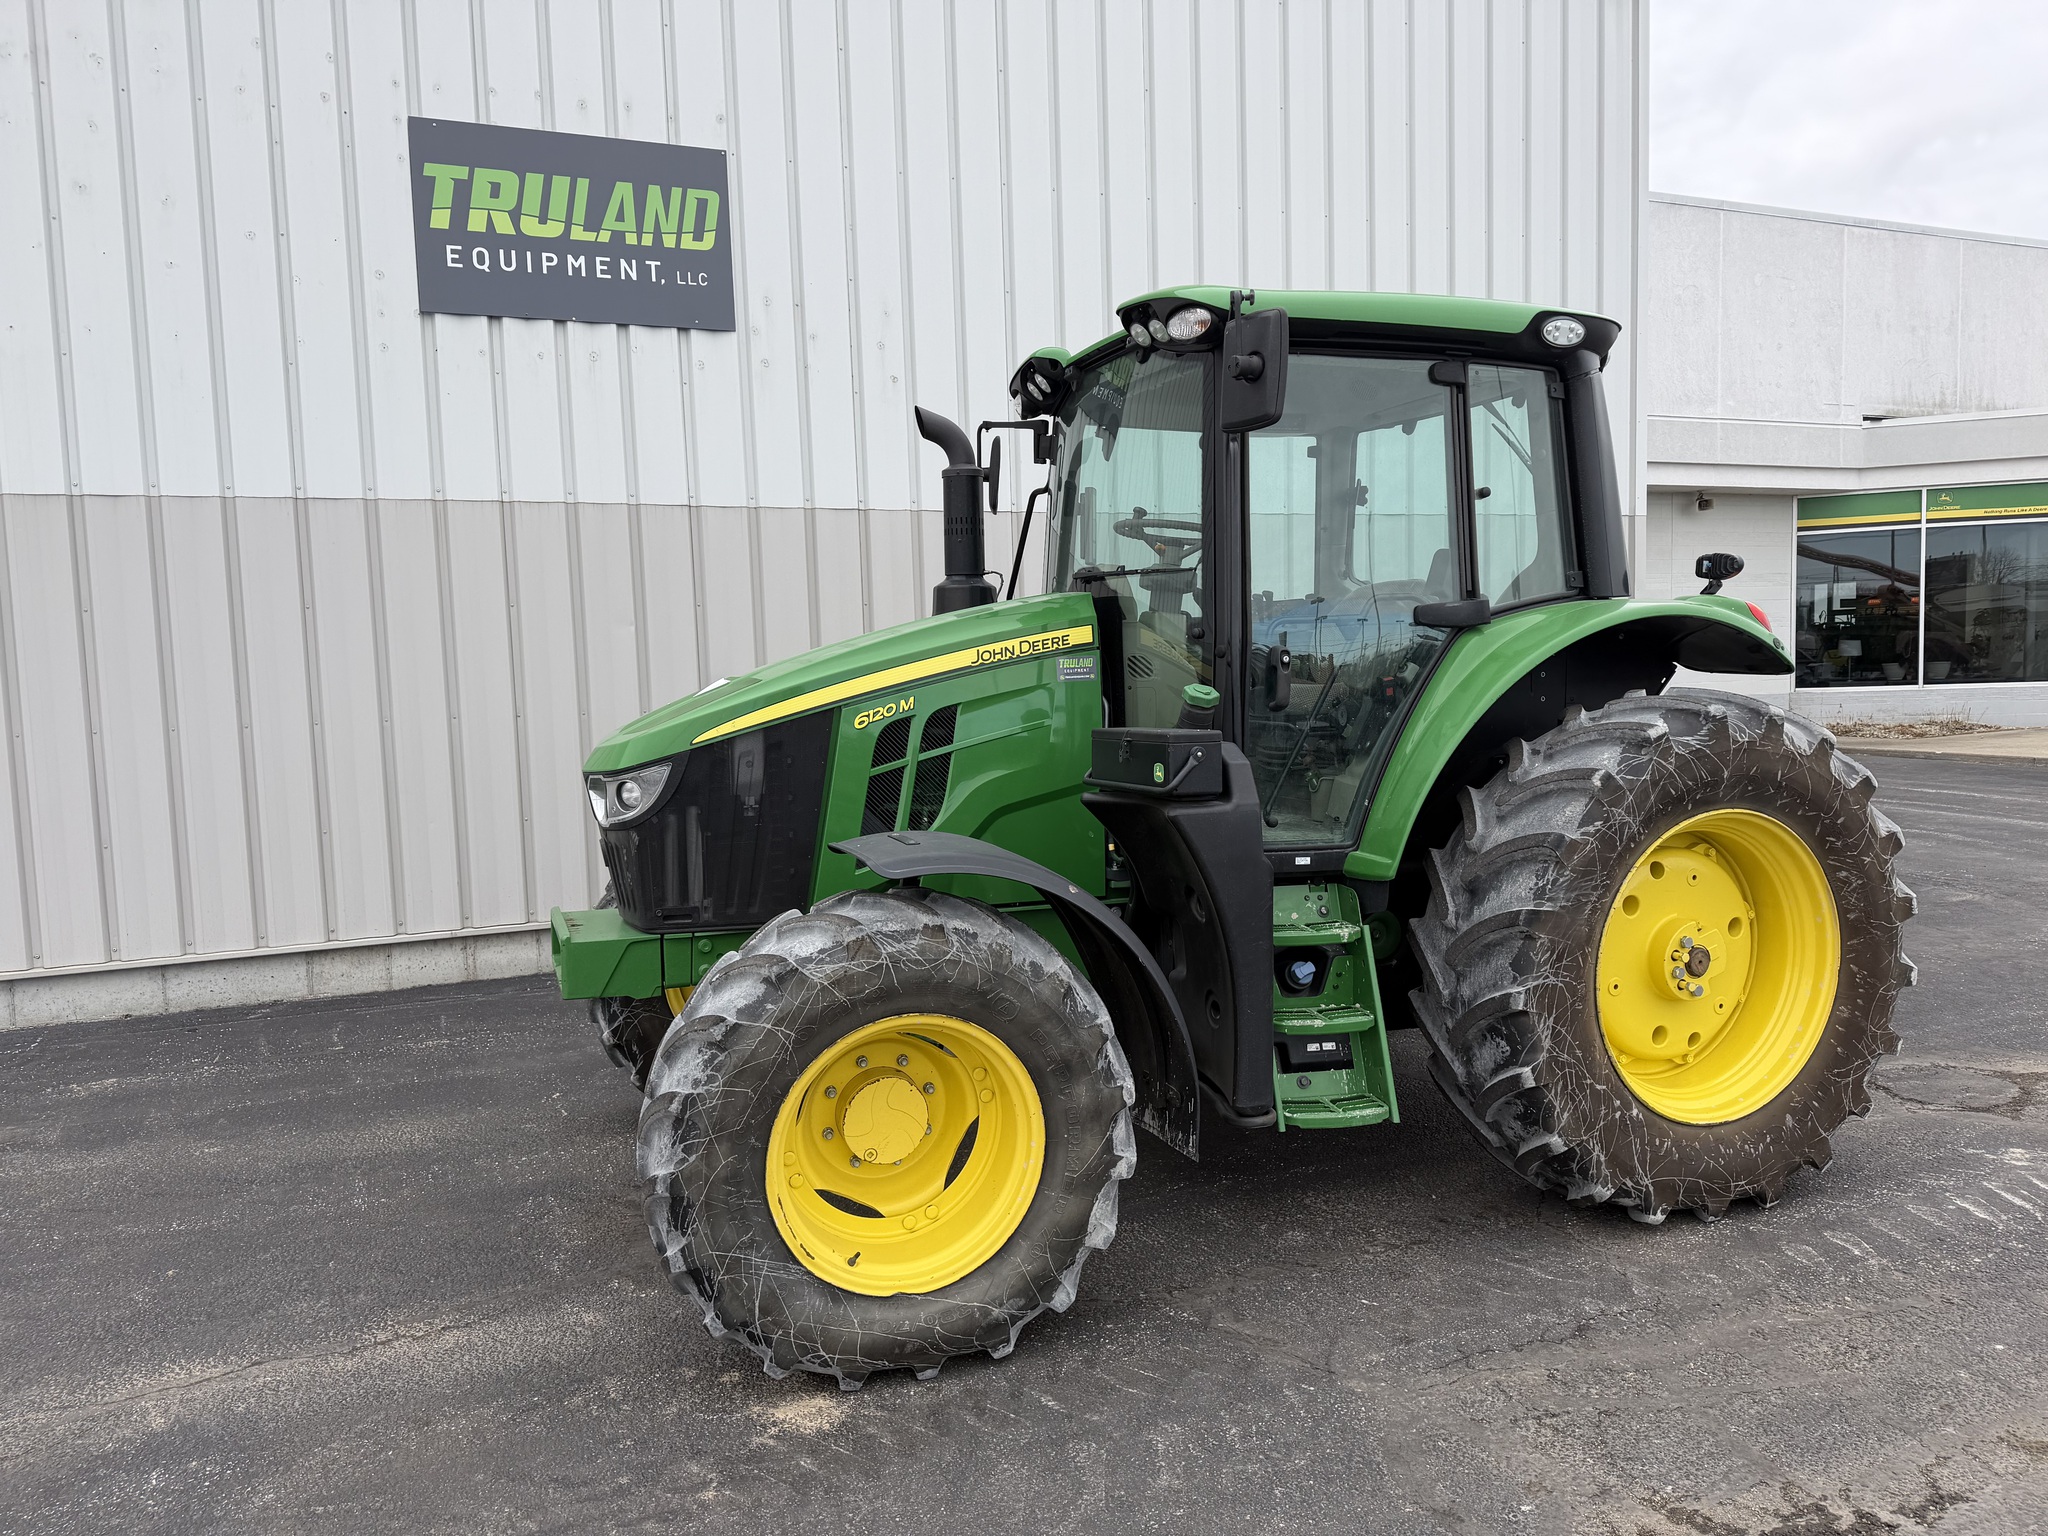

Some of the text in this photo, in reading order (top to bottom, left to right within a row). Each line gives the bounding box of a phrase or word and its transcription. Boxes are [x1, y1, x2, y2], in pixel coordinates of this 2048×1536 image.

[423, 162, 720, 251] TRULAND
[446, 244, 708, 286] EQUIPMENT, LLC
[971, 634, 1070, 665] JOHN DEERE
[1058, 657, 1094, 668] TRULAND
[853, 696, 915, 730] 6120 M
